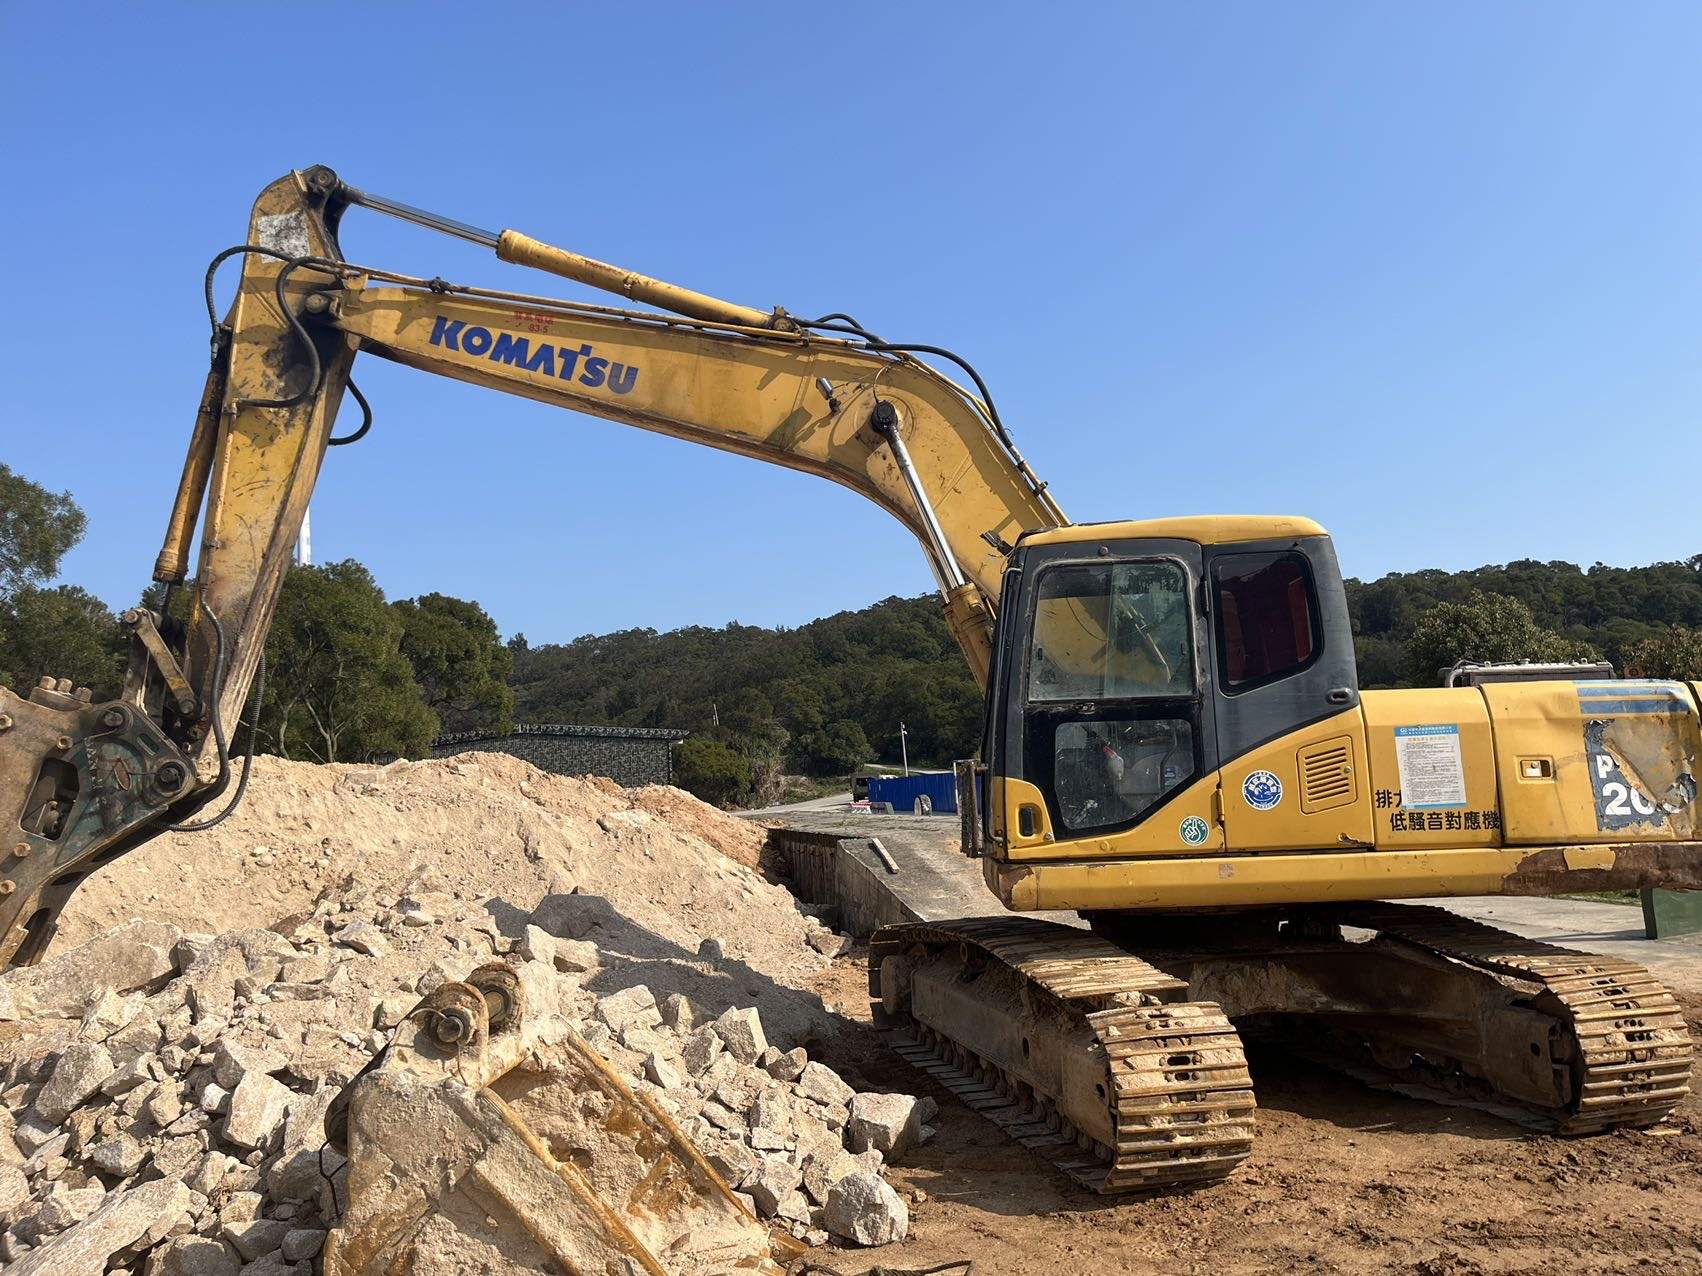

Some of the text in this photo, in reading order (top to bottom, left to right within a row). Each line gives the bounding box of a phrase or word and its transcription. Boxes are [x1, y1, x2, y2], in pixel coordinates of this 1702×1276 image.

[429, 315, 639, 395] KOMATSU
[1596, 754, 1619, 778] P
[1390, 810, 1500, 831] 低騷音對應機
